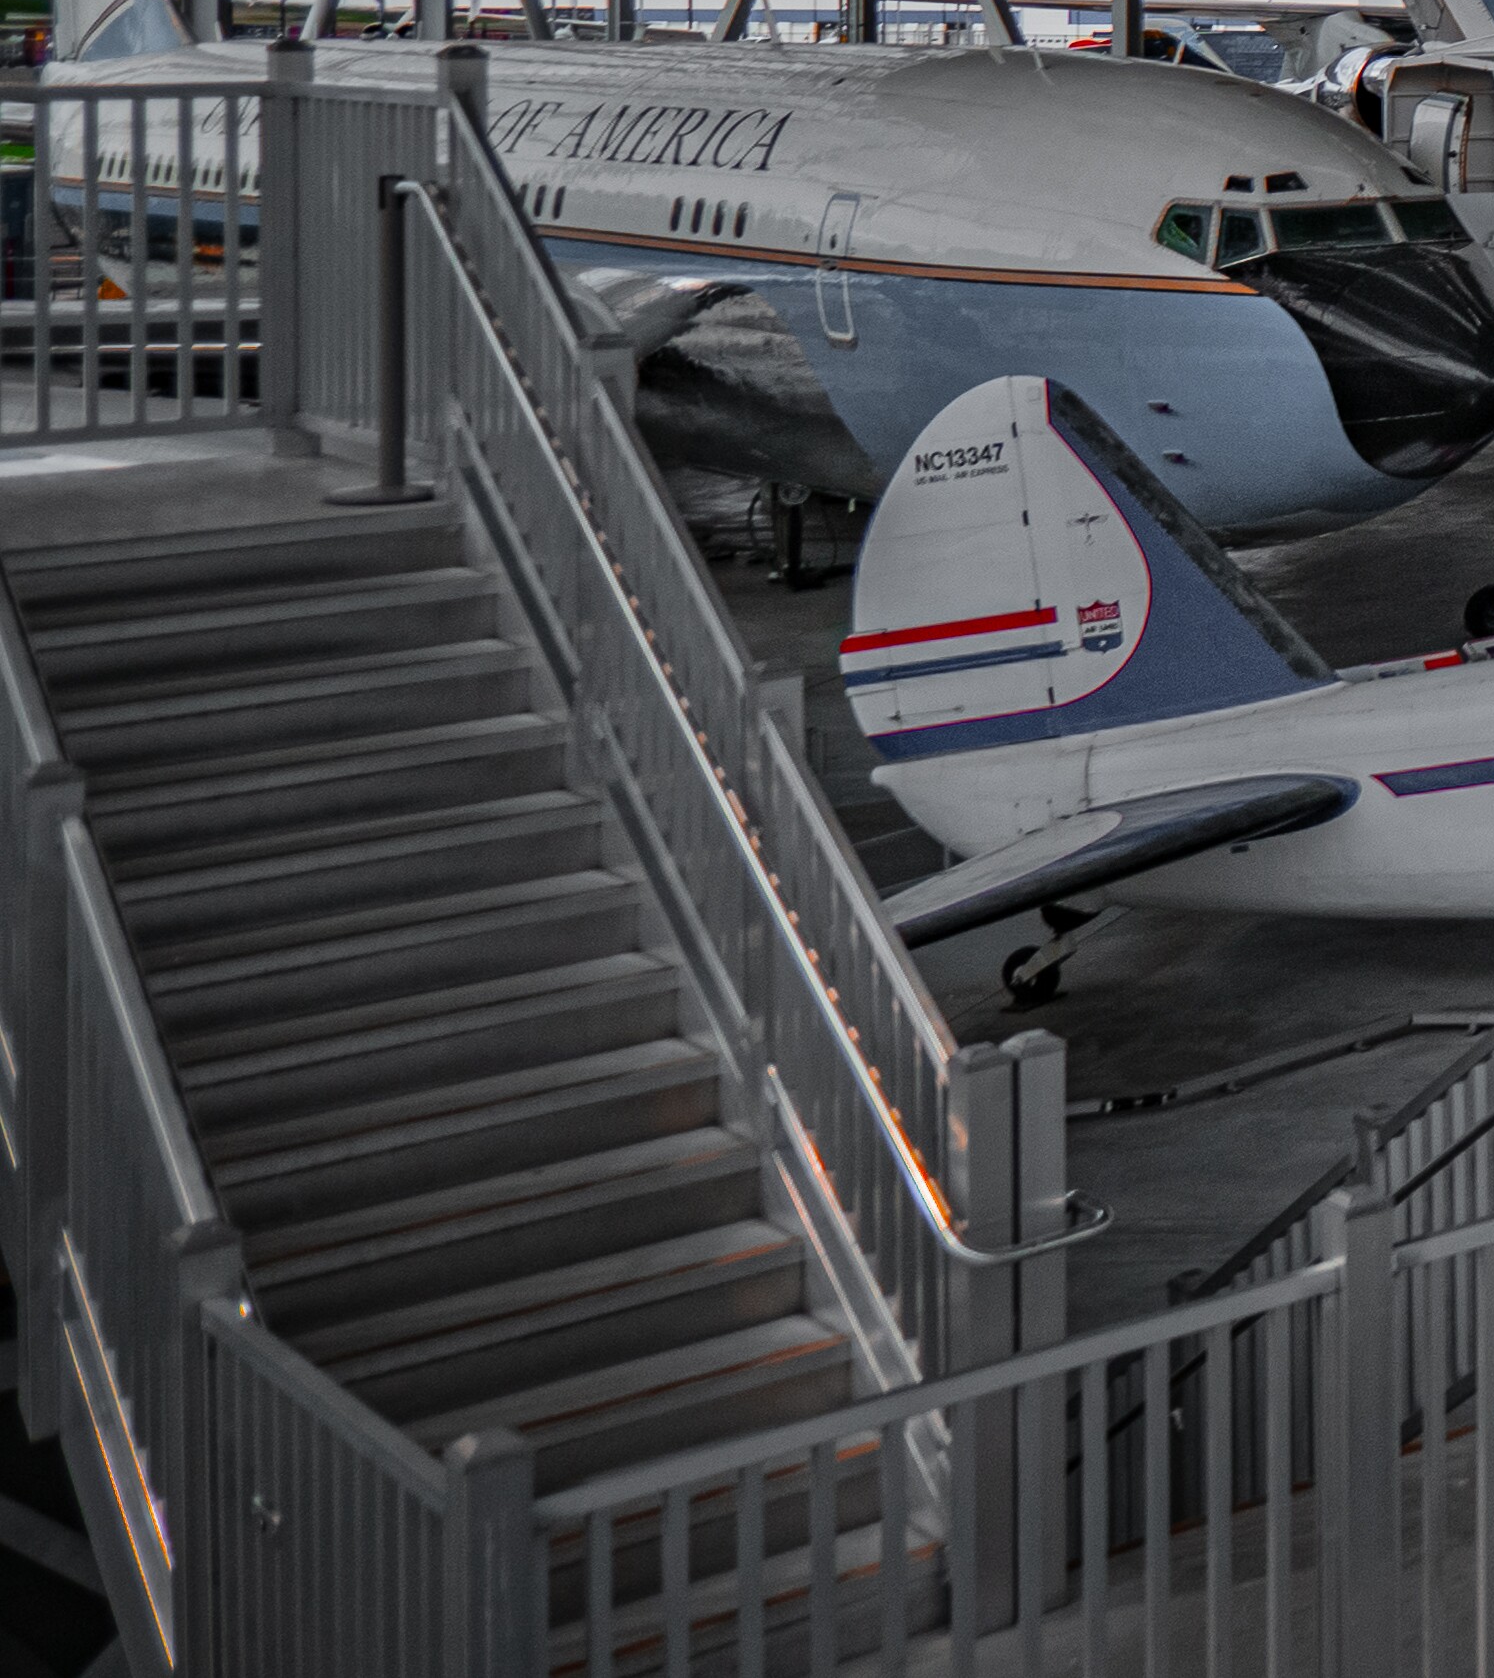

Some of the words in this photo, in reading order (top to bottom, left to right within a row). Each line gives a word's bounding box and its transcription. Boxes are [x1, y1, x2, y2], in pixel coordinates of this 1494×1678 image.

[489, 98, 573, 155] OF
[548, 102, 796, 172] AMERICA
[914, 442, 1004, 474] NC13347
[1079, 605, 1120, 622] UNITED
